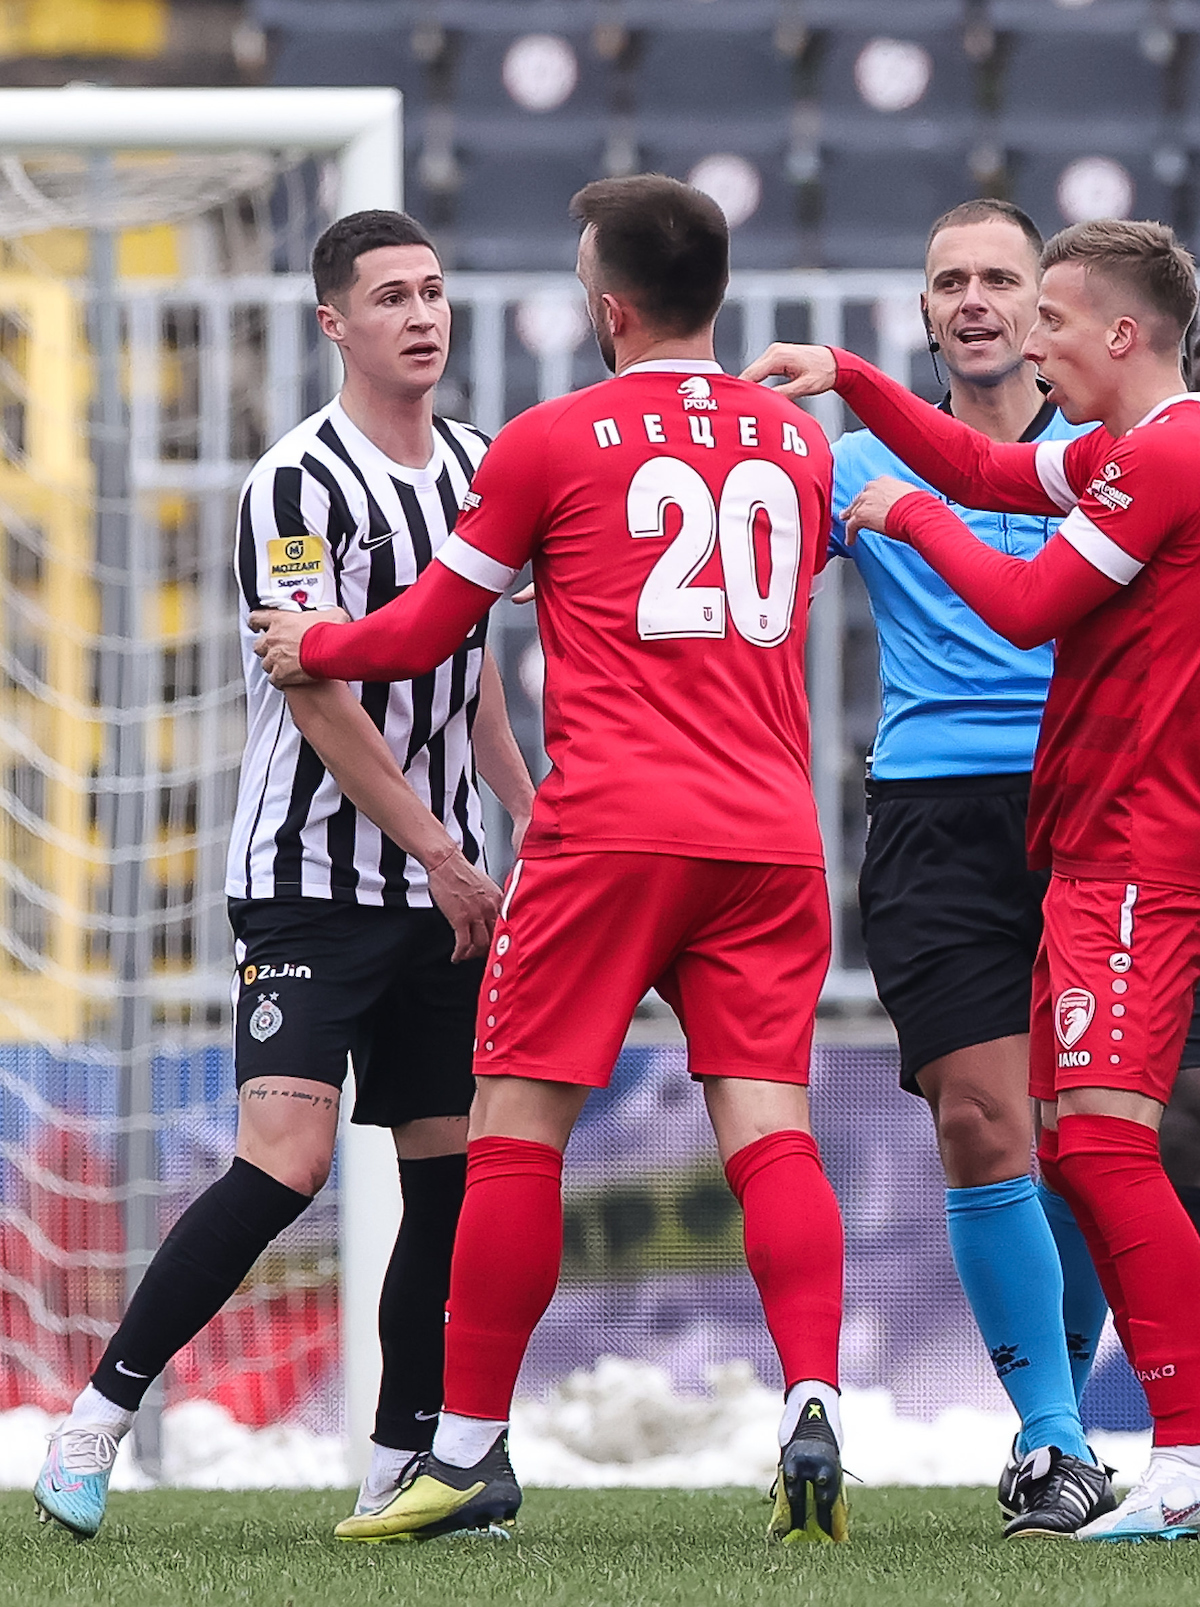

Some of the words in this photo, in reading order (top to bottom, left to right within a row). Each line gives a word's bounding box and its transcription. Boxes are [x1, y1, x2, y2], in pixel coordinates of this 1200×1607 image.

[593, 413, 808, 457] ПЕЦЕЉ
[272, 560, 321, 574] MOZZART
[627, 456, 801, 648] 20
